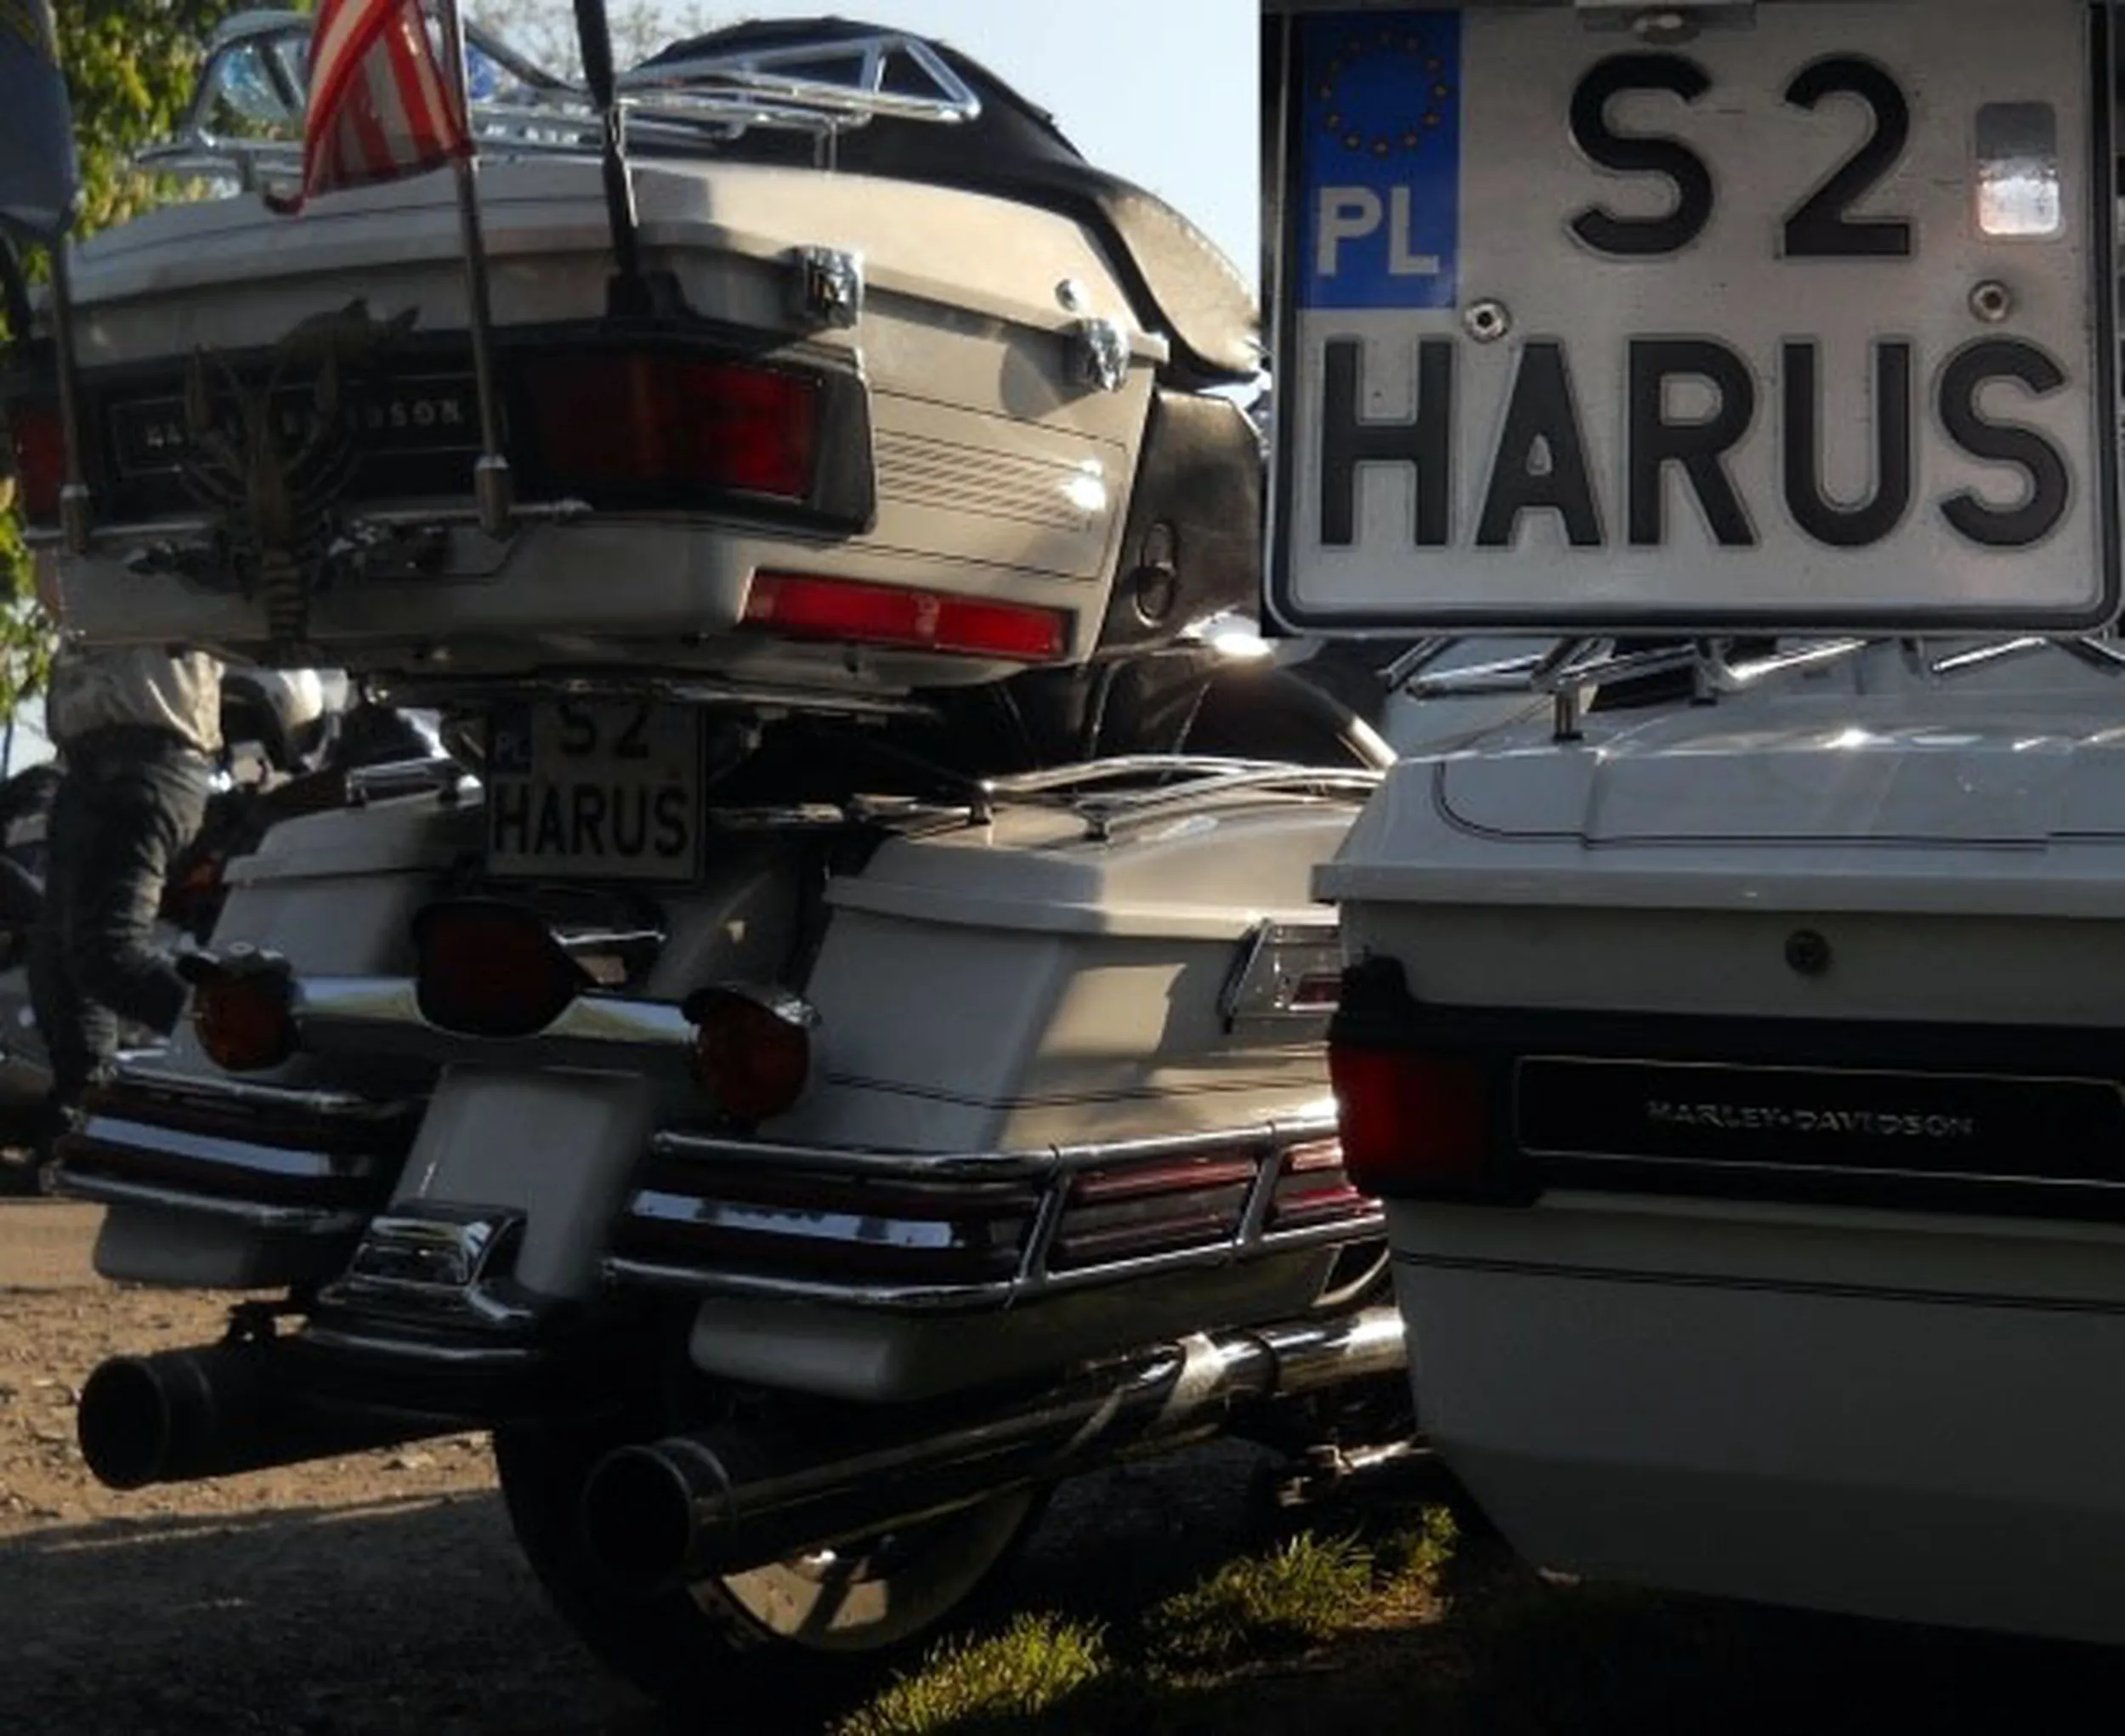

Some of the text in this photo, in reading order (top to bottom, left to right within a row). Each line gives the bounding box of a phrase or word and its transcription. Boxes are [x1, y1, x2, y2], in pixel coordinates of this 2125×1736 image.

[1317, 185, 1441, 276] PL
[1319, 339, 2071, 548] HARUS
[494, 783, 688, 858] HARUS
